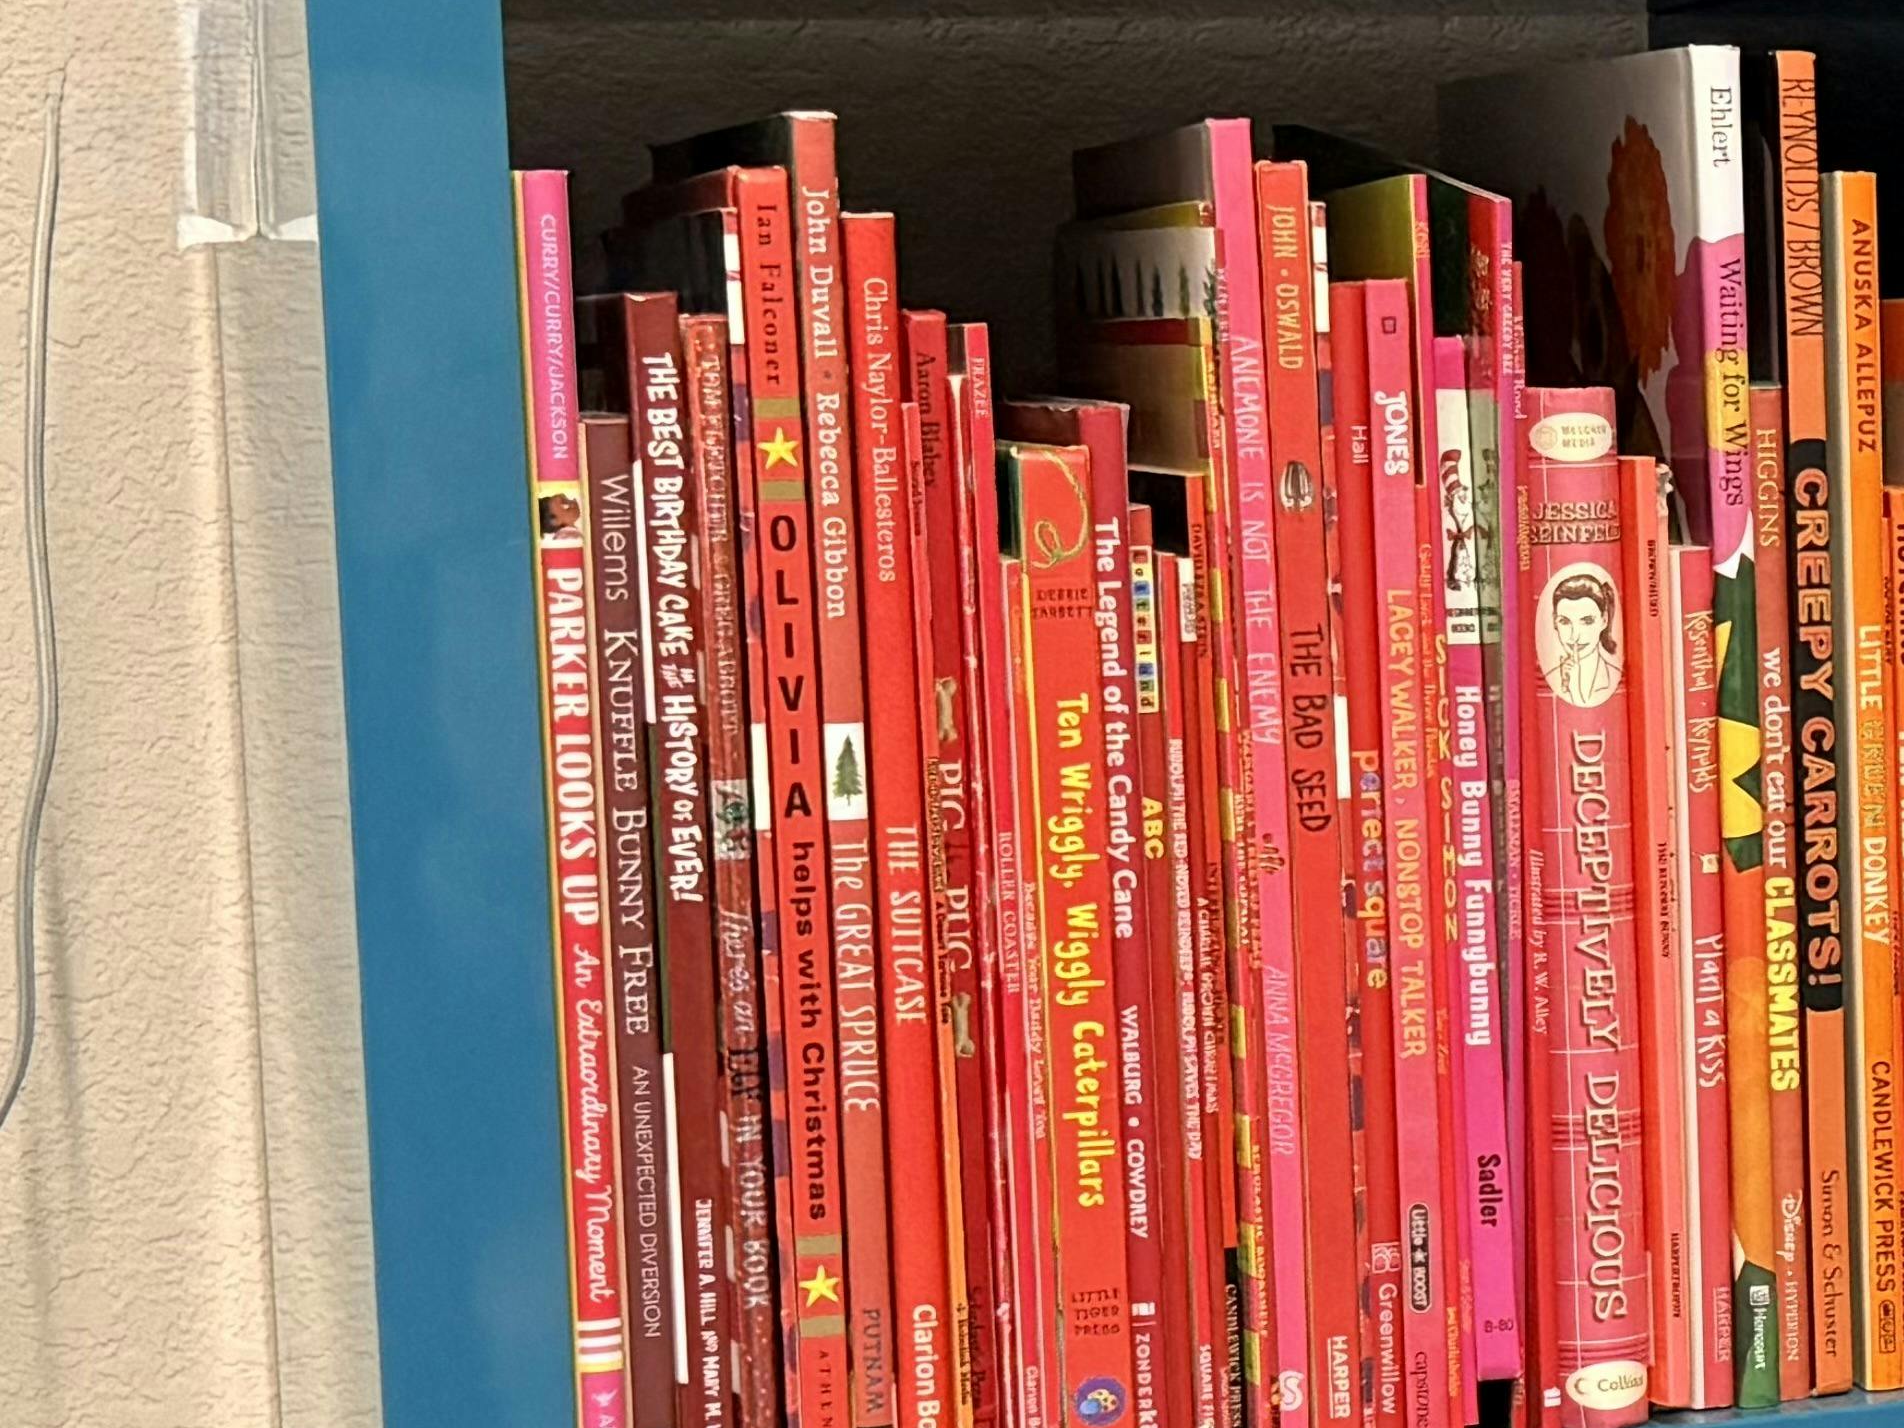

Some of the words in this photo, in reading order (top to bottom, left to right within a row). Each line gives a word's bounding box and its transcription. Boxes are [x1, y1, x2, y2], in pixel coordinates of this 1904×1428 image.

[1707, 84, 1732, 168] Ehlert
[540, 213, 566, 460] CURRY/CURRY/JACKSON
[1714, 257, 1749, 366] Waiting
[641, 351, 675, 403] THE
[1720, 371, 1748, 414] for
[646, 408, 683, 468] BEST
[1350, 424, 1369, 465] Hall
[1718, 420, 1750, 507] Wings
[600, 473, 629, 602] Willems
[650, 475, 687, 589] BIRTHDAY
[657, 593, 690, 657] CAKE
[1793, 467, 1834, 701] CREEPY
[546, 568, 593, 721] PARKER
[769, 515, 812, 818] OLIVIA
[1289, 623, 1325, 678] THE
[1761, 646, 1784, 689] we
[602, 628, 639, 793] KNUFFLE
[660, 694, 694, 794] HISTORY
[1053, 693, 1091, 749] Ten
[1292, 694, 1330, 751] BAD
[1451, 685, 1483, 770] Honey
[1763, 693, 1789, 765] don't
[555, 734, 596, 861] LOOKS
[671, 799, 691, 822] OF
[1046, 762, 1097, 889] Wriggly,
[1295, 767, 1333, 834] SEED
[1457, 779, 1490, 869] Bunny
[1765, 772, 1788, 813] eat
[610, 806, 648, 929] BUNNY
[668, 825, 704, 903] EVER!
[790, 840, 815, 937] helps
[833, 838, 868, 891] The
[886, 825, 919, 874] THE
[1568, 729, 1622, 1053] DECEPTIVELY
[1766, 821, 1788, 868] our
[1801, 715, 1843, 987] CARROTS!
[561, 874, 599, 926] UP
[618, 942, 654, 1036] FREE
[797, 949, 820, 1029] with
[836, 902, 873, 996] GREAT
[890, 889, 926, 1026] SUITCASE
[1055, 902, 1106, 1007] Wiggly
[1461, 878, 1496, 1047] Funnybunny
[1764, 875, 1801, 1092] CLASSMATES
[631, 1065, 650, 1097] AN
[841, 1004, 880, 1113] SPRUCE
[800, 1040, 830, 1221] Christmas
[1062, 1020, 1115, 1210] Caterpillars
[1871, 1060, 1896, 1214] CANDLEWICK
[631, 1101, 657, 1228] UNEXPECTED
[1476, 1153, 1502, 1229] Sadler
[1581, 1071, 1628, 1323] DELICIOUS
[637, 1233, 662, 1338] DIVERSION
[1874, 1219, 1898, 1293] PRESS
[1331, 1335, 1351, 1419] HARPER
[1377, 1282, 1399, 1415] Greenwillow
[1409, 1350, 1431, 1428] capstone
